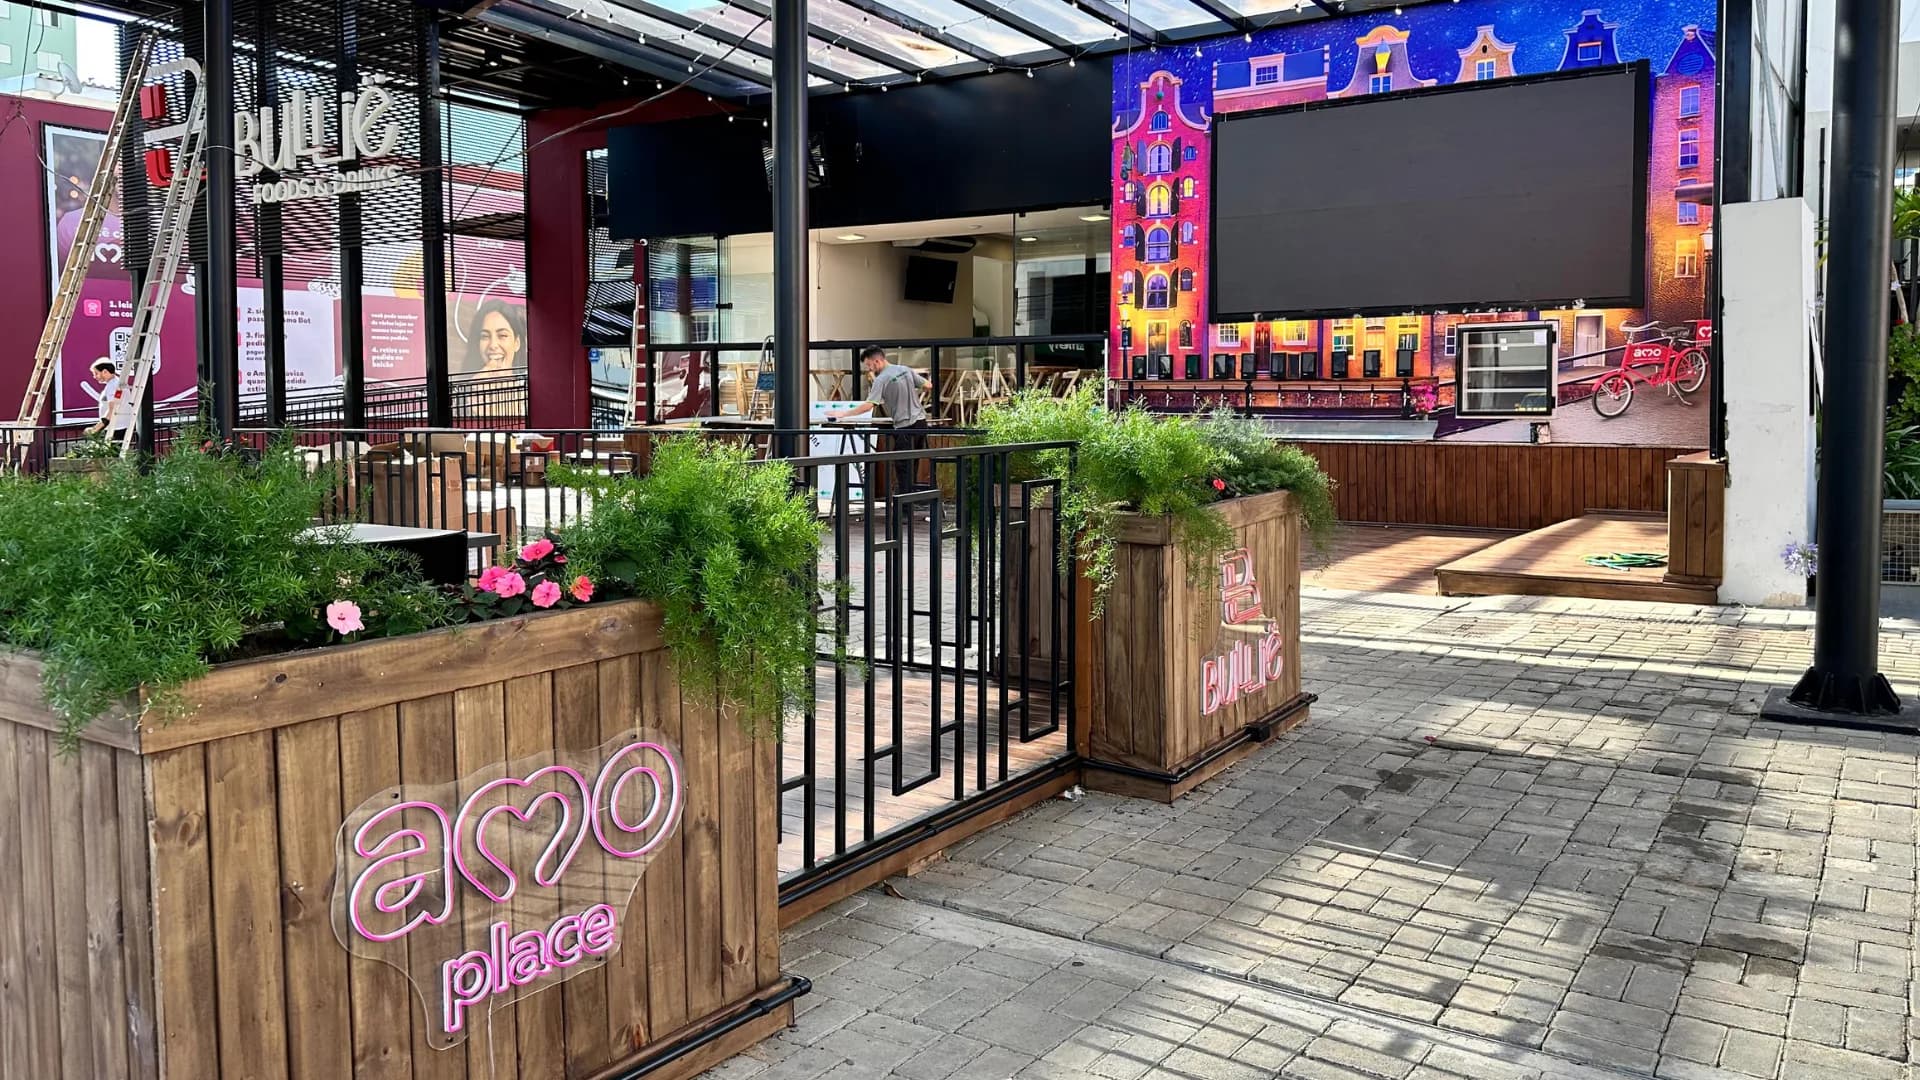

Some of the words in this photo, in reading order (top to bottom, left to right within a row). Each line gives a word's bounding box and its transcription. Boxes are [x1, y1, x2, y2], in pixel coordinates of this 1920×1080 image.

[253, 178, 312, 204] FOODS
[314, 176, 328, 196] &
[333, 165, 402, 194] DRINKS
[442, 903, 617, 1033] place
